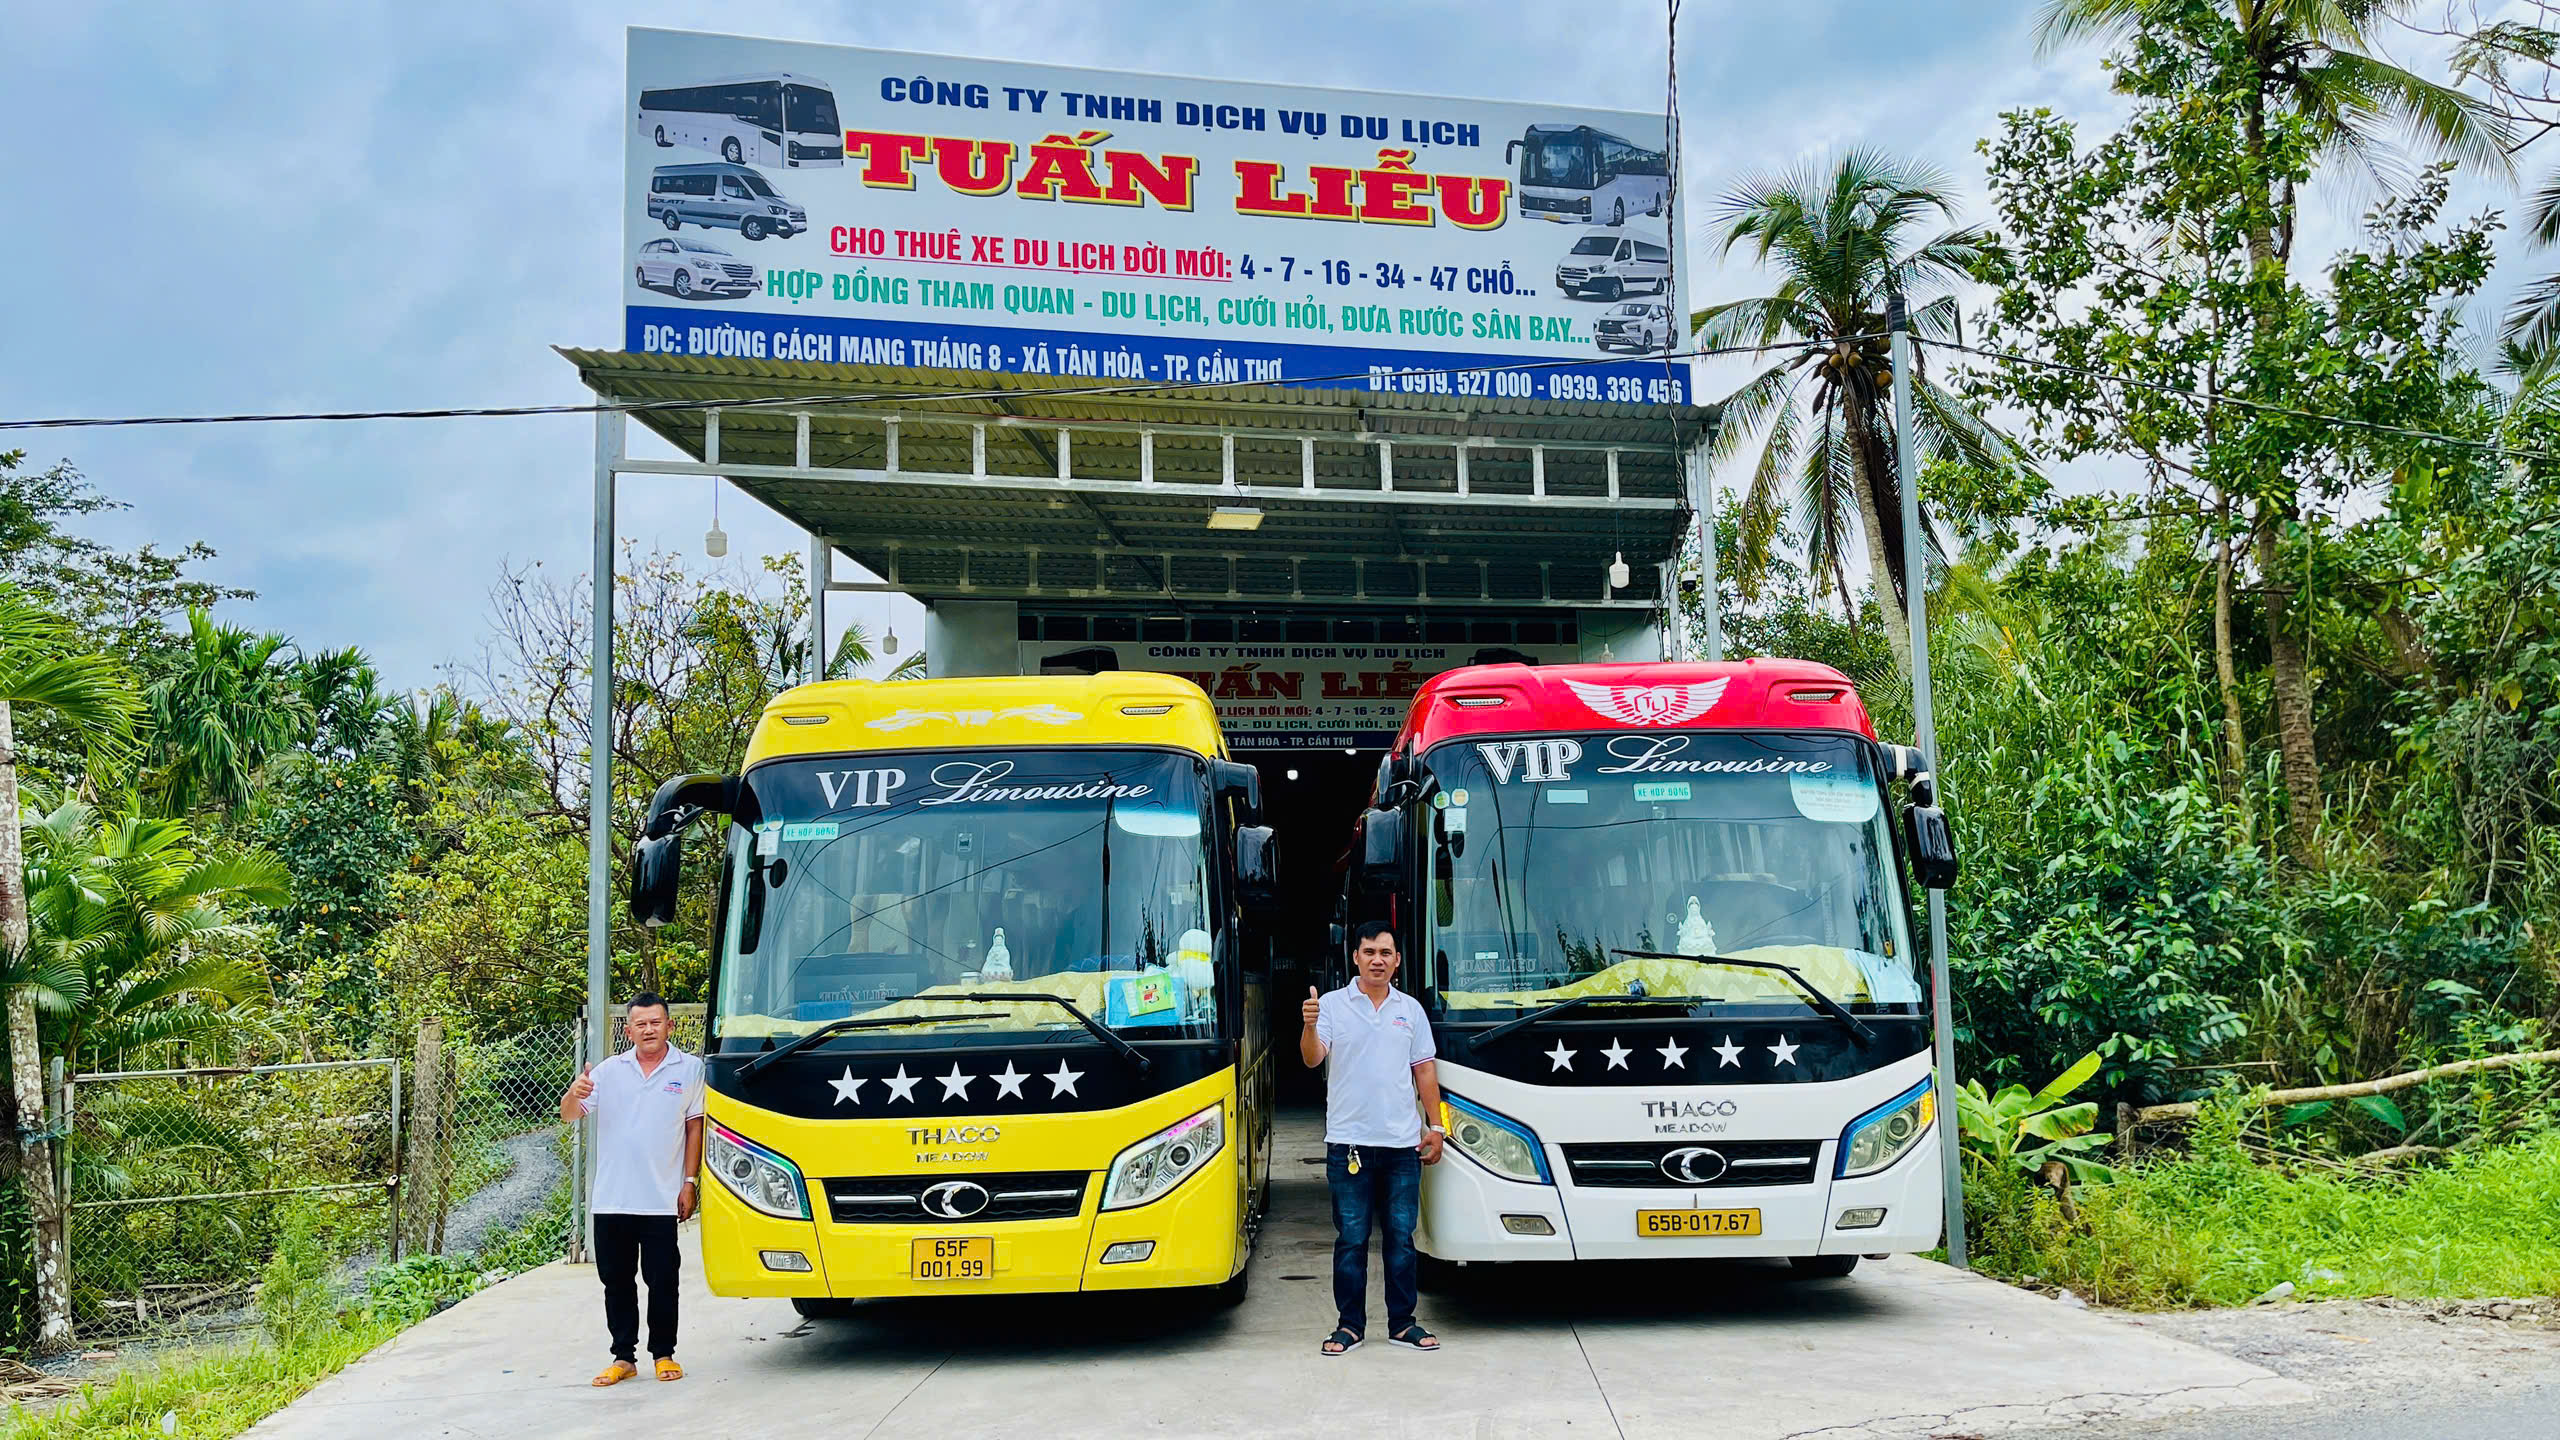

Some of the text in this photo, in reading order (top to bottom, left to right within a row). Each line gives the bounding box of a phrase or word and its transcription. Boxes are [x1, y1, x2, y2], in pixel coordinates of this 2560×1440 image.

[881, 76, 1479, 147] CÔNG TY TNHH DỊCH VỤ DU LỊCH
[845, 130, 1512, 231] TUẤN LIỄU
[830, 225, 885, 255] CHO
[895, 229, 961, 260] THUÊ
[971, 235, 1004, 263] XE
[1014, 238, 1048, 267] DU
[1058, 241, 1115, 274] LỊCH
[1123, 240, 1166, 274] ĐỜI
[1175, 246, 1232, 278] MỚI:
[1240, 254, 1255, 280] 4
[1280, 256, 1295, 283] 7
[1322, 259, 1350, 286] 16
[1376, 263, 1405, 289] 34
[1430, 266, 1458, 292] 47
[1467, 260, 1536, 296] CHỖ...
[767, 268, 823, 304] HỢP
[832, 266, 909, 305] ĐỒNG
[918, 279, 994, 310] THAM
[1004, 285, 1074, 315] QUAN
[1102, 291, 1136, 318] DU
[1145, 294, 1209, 327] LỊCH,
[1218, 295, 1276, 327] CƯỚI
[1285, 295, 1334, 333] HỎI,
[1341, 305, 1391, 333] ĐƯA
[1399, 306, 1464, 337] RƯỚC
[1472, 309, 1521, 340] SÂN
[1529, 316, 1591, 344] BAY...
[644, 324, 682, 353] ĐC:
[687, 322, 766, 358] ĐƯỜNG
[773, 327, 833, 362] CÁCH
[910, 336, 983, 370] THÁNG
[988, 345, 1001, 371] 8
[1022, 342, 1051, 374] XÃ
[1055, 344, 1097, 376] TÂN
[1103, 345, 1145, 378] HÒA
[1164, 354, 1191, 381] TP.
[1197, 348, 1239, 382] CẦN
[1244, 358, 1283, 385] THƠ
[1401, 366, 1453, 394] 0919.
[1457, 371, 1490, 396] 527
[1495, 371, 1532, 398] 000
[1549, 374, 1603, 401] 0939.
[1606, 376, 1643, 402] 336
[1647, 378, 1683, 403] 456
[1149, 645, 1445, 660] CÔNG TY TNHH DỊCH VỤ DU LỊCH
[1315, 706, 1323, 716] 4
[1334, 706, 1342, 716] 7
[1353, 706, 1368, 716] 16
[1379, 706, 1396, 716] 29
[1252, 720, 1272, 729] DU
[1290, 736, 1305, 746] TP.
[1476, 735, 1833, 784] VIP Limousine
[815, 760, 1154, 809] VIP Limousine
[1641, 1100, 1737, 1118] THACO
[905, 1125, 1000, 1145] THACO
[1655, 1122, 1727, 1133] MEADOW
[916, 1151, 989, 1163] MEADOW
[1648, 1214, 1750, 1231] 65B-017.67
[935, 1240, 969, 1257] 65F
[920, 1260, 983, 1278] 001.99
